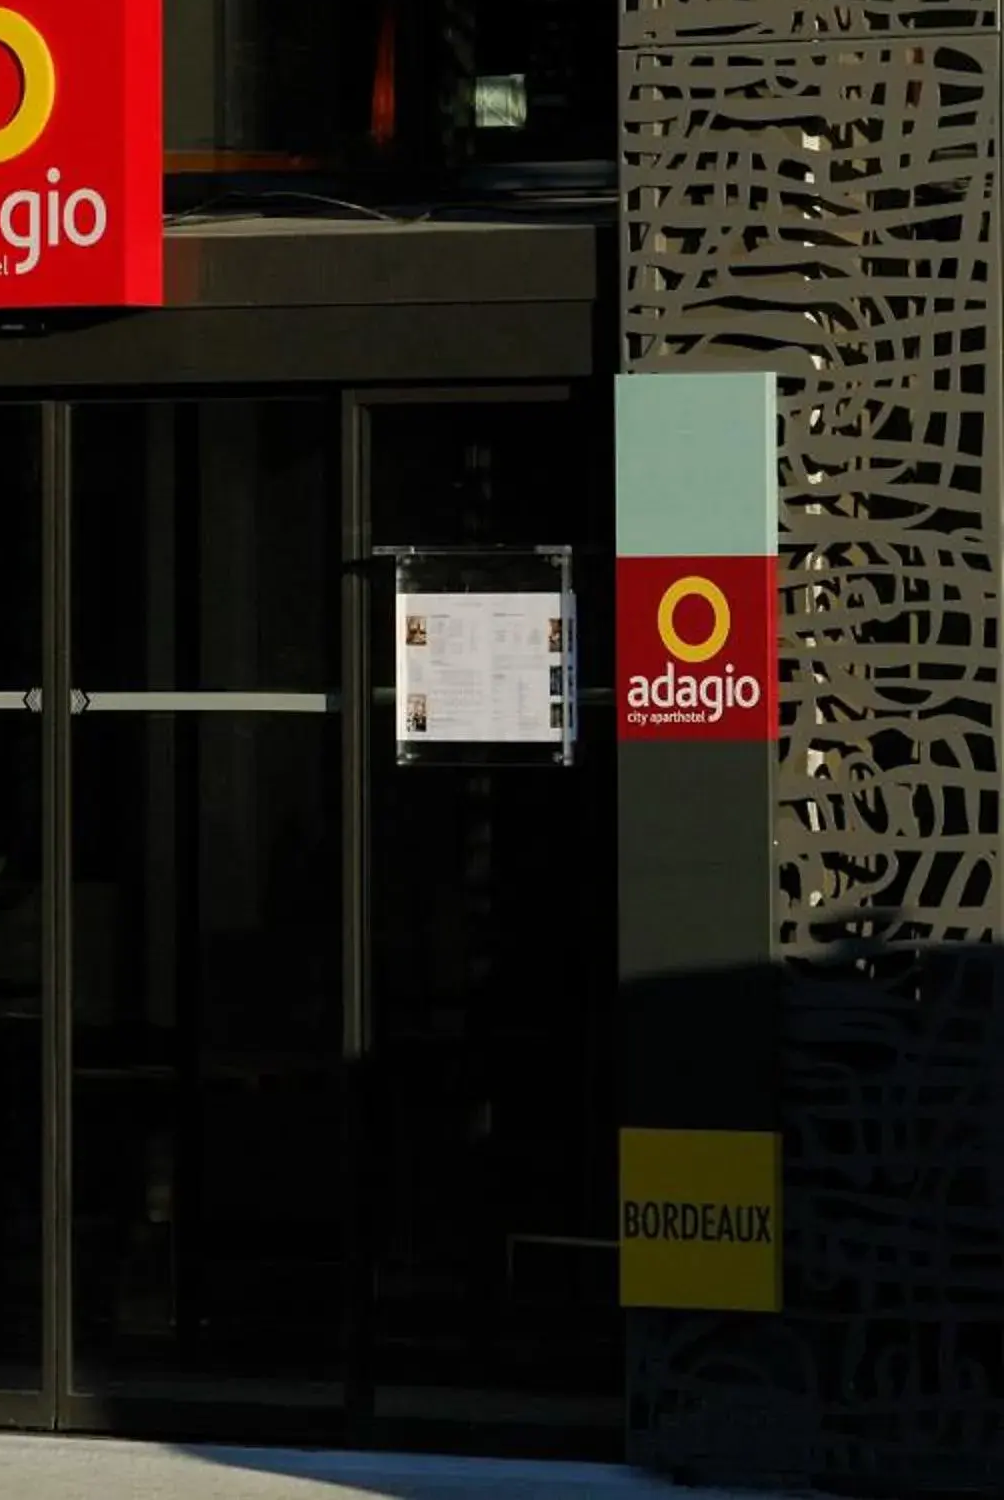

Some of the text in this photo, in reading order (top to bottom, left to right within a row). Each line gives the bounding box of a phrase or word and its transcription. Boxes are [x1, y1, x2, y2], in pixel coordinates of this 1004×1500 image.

[627, 661, 761, 723] adagio
[627, 709, 706, 727] city aparthotel
[623, 1200, 772, 1244] BORDEAUX
